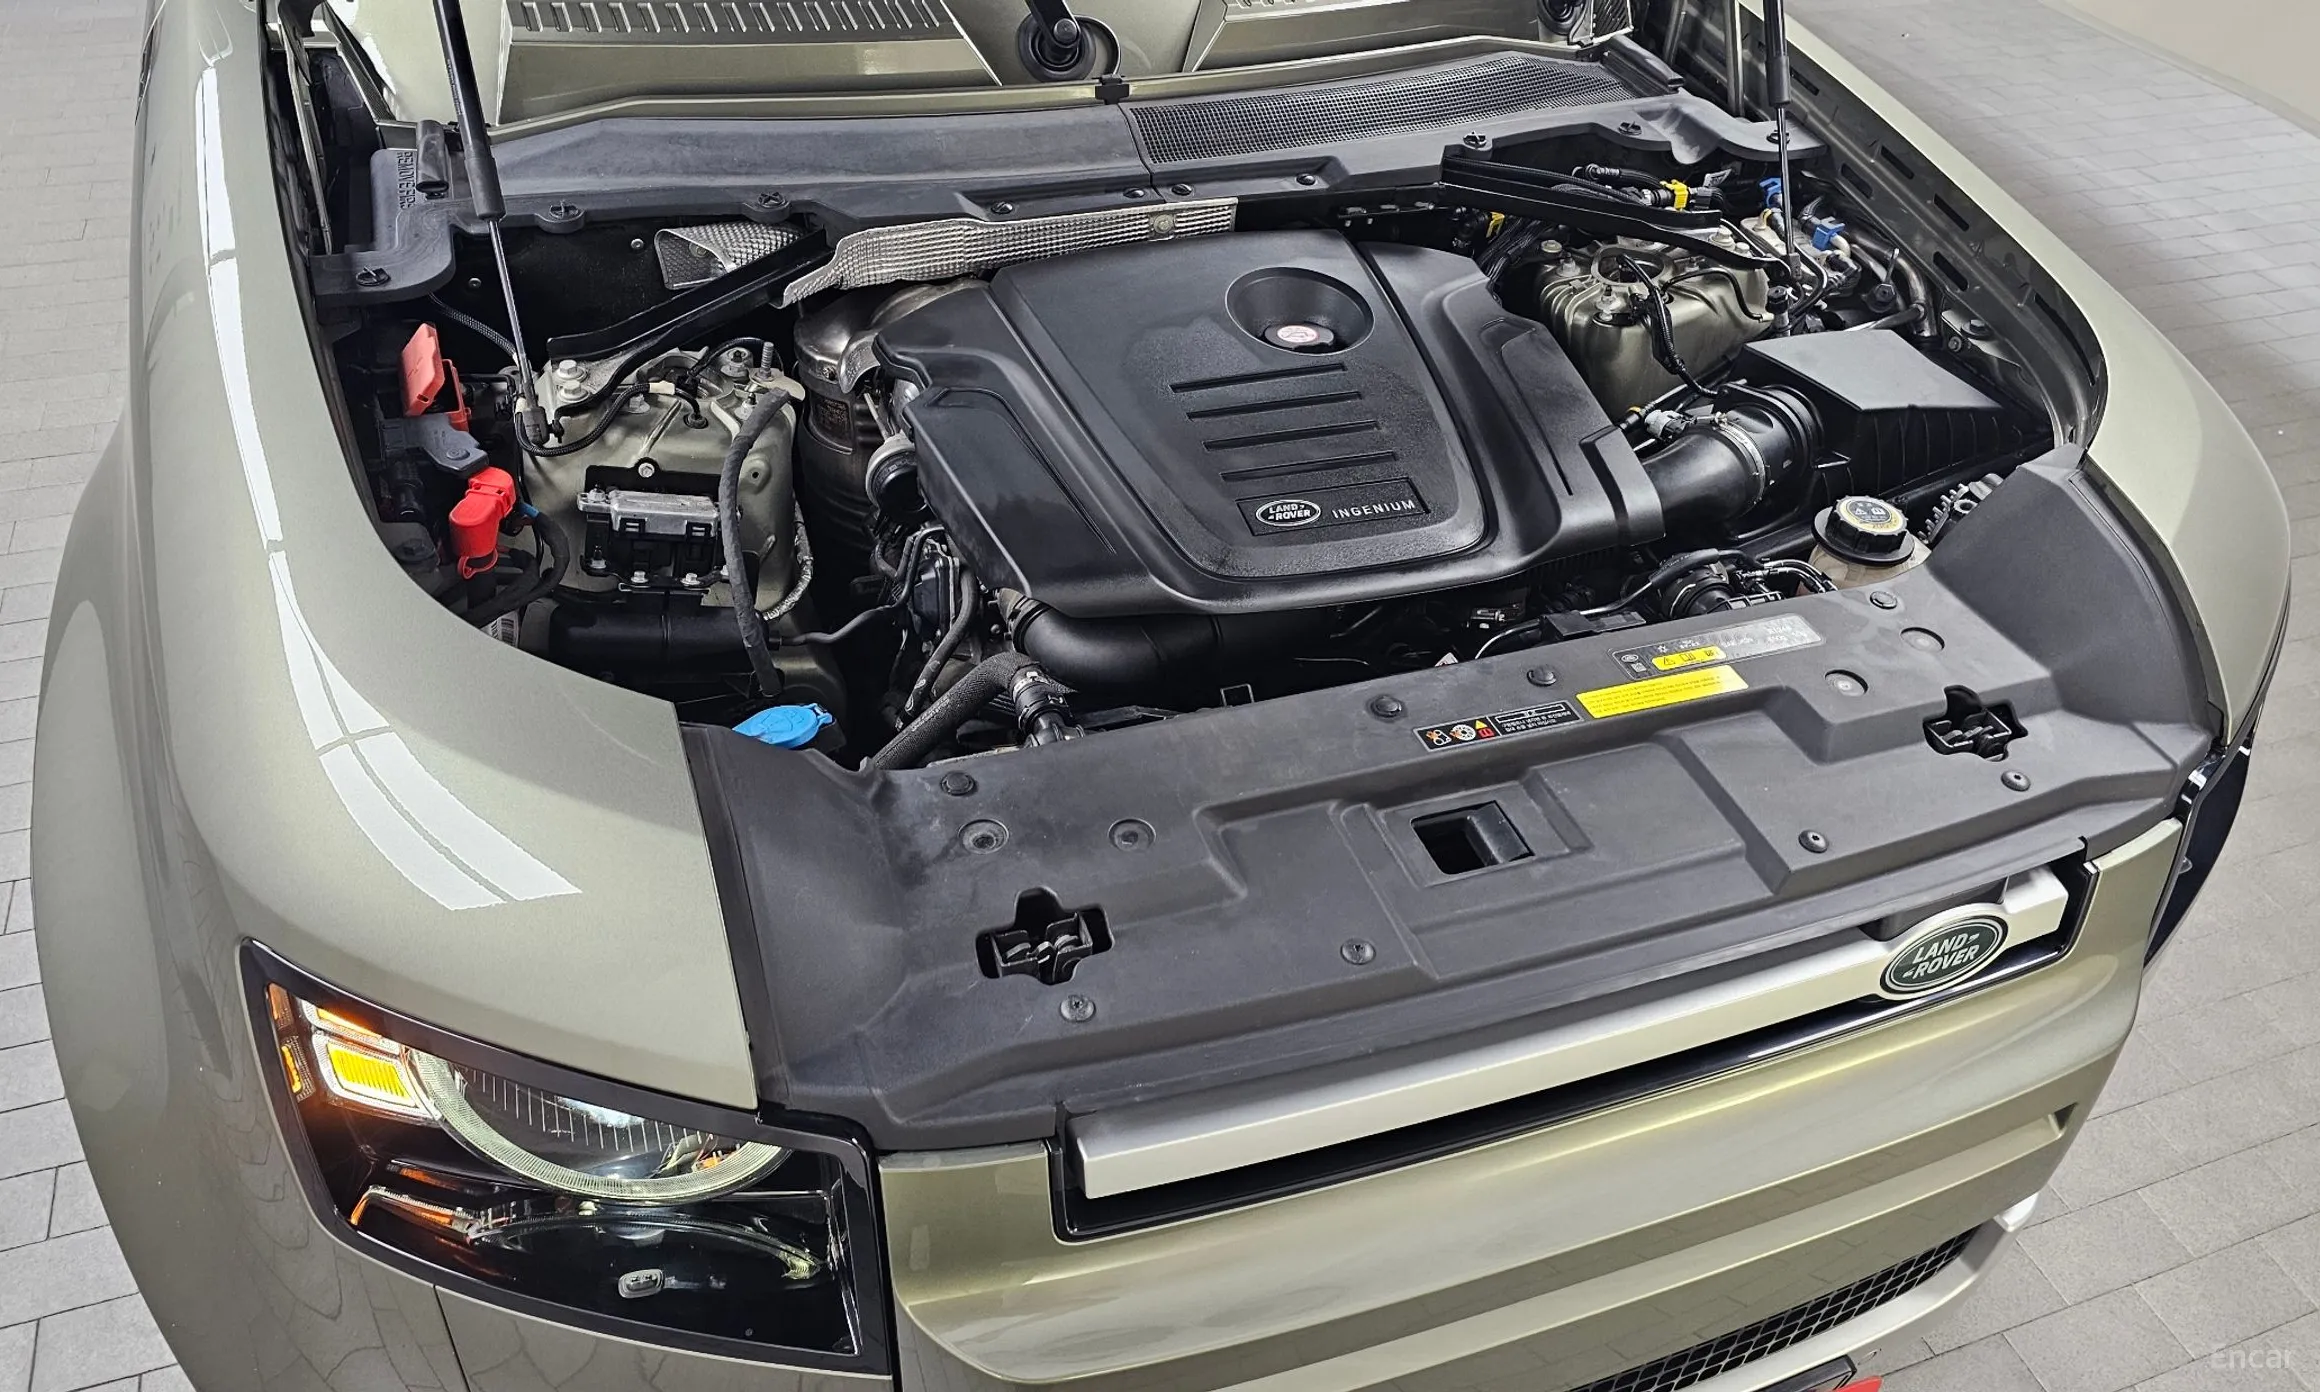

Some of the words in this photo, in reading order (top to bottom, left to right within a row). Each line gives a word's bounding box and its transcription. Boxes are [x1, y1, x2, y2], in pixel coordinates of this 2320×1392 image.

[397, 151, 416, 188] REMOVE
[1269, 503, 1298, 514] LAND
[1275, 509, 1311, 521] ROVER
[1332, 499, 1416, 519] INGENIUM
[1912, 933, 1969, 964] LAND
[1912, 944, 1980, 979] ROVER
